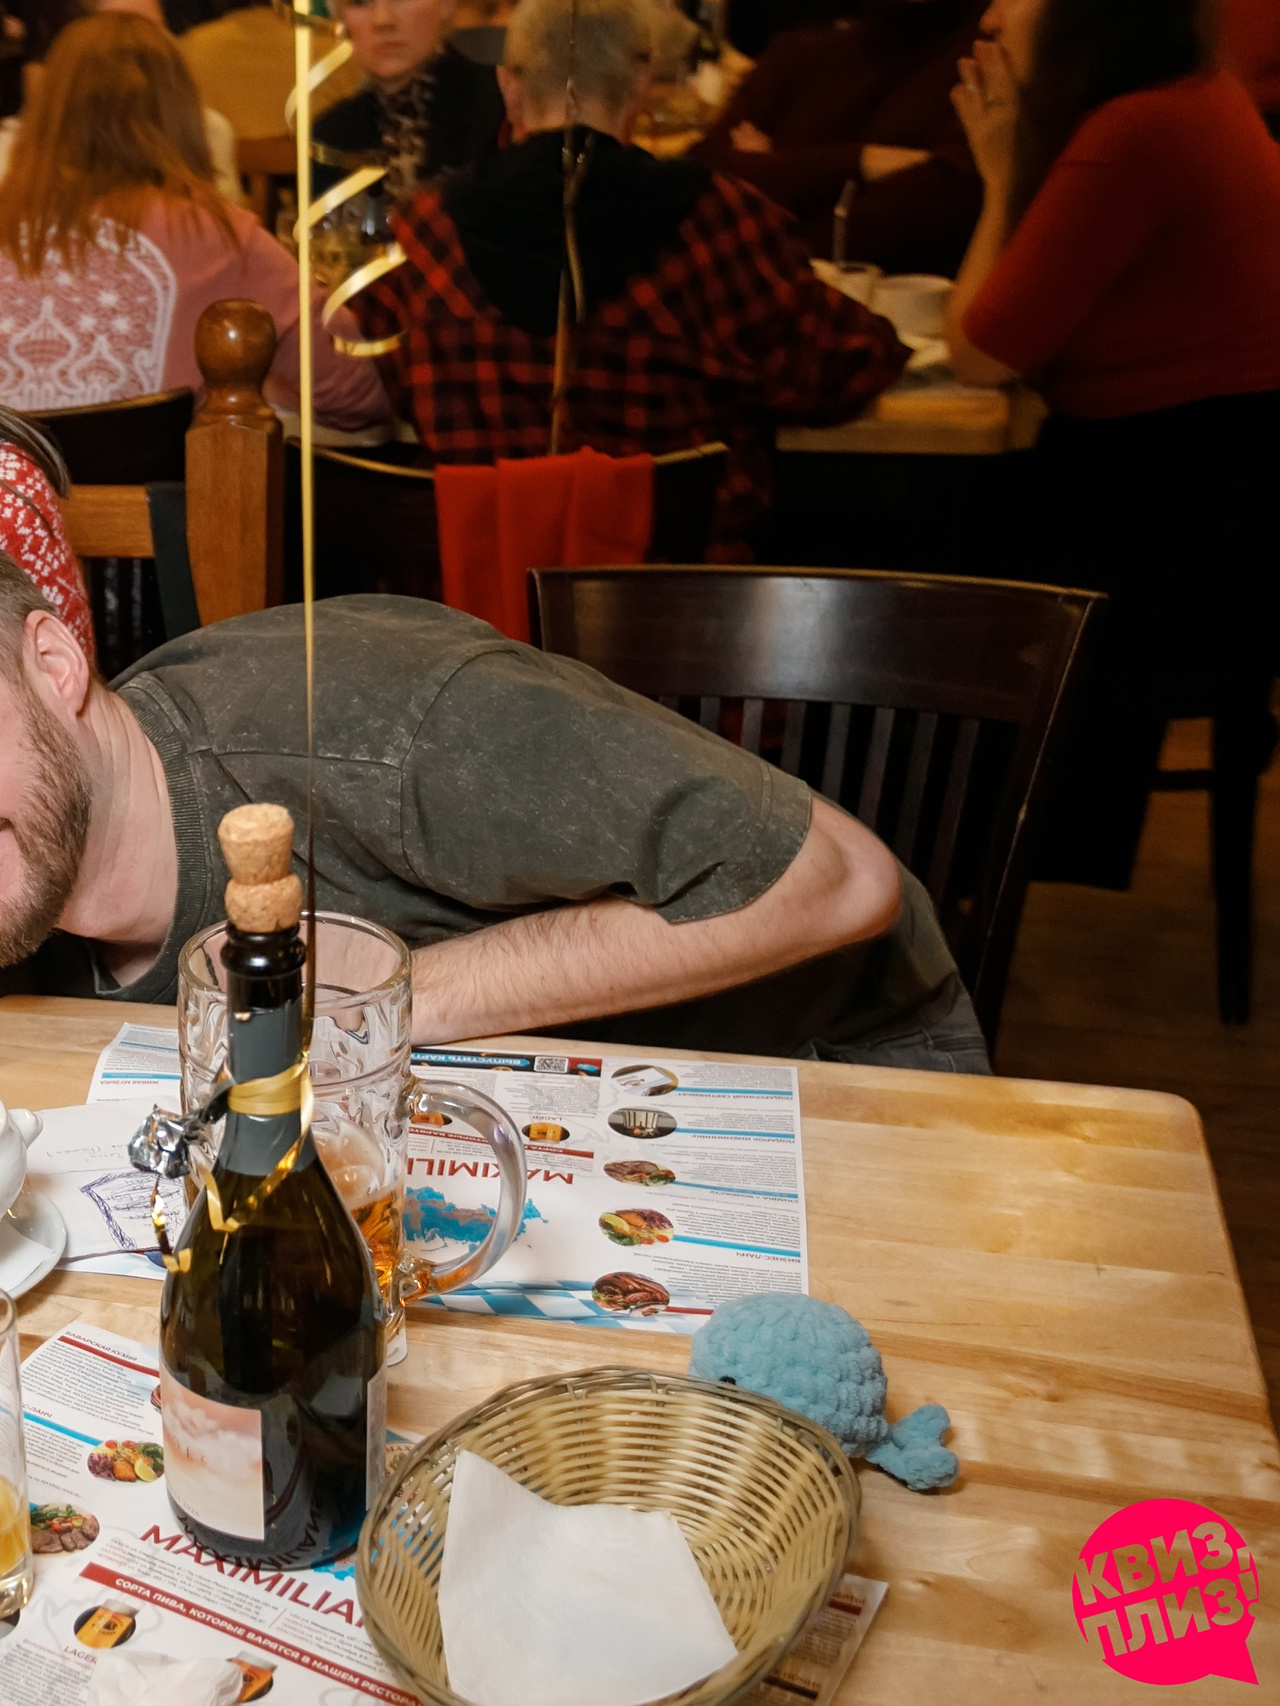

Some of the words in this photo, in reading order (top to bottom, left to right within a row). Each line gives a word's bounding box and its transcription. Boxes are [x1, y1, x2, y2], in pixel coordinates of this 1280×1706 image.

[450, 1055, 522, 1066] ВЫПУСТИТЬ
[140, 1524, 366, 1629] MAXIMILIA
[115, 1578, 152, 1600] СОРТА
[152, 1593, 187, 1614] ПИВА,
[188, 1608, 247, 1637] КОТОРЫЕ
[246, 1630, 302, 1661] ВАРЯТСЯ
[300, 1653, 312, 1666] В
[311, 1658, 360, 1687] НАШЕМ
